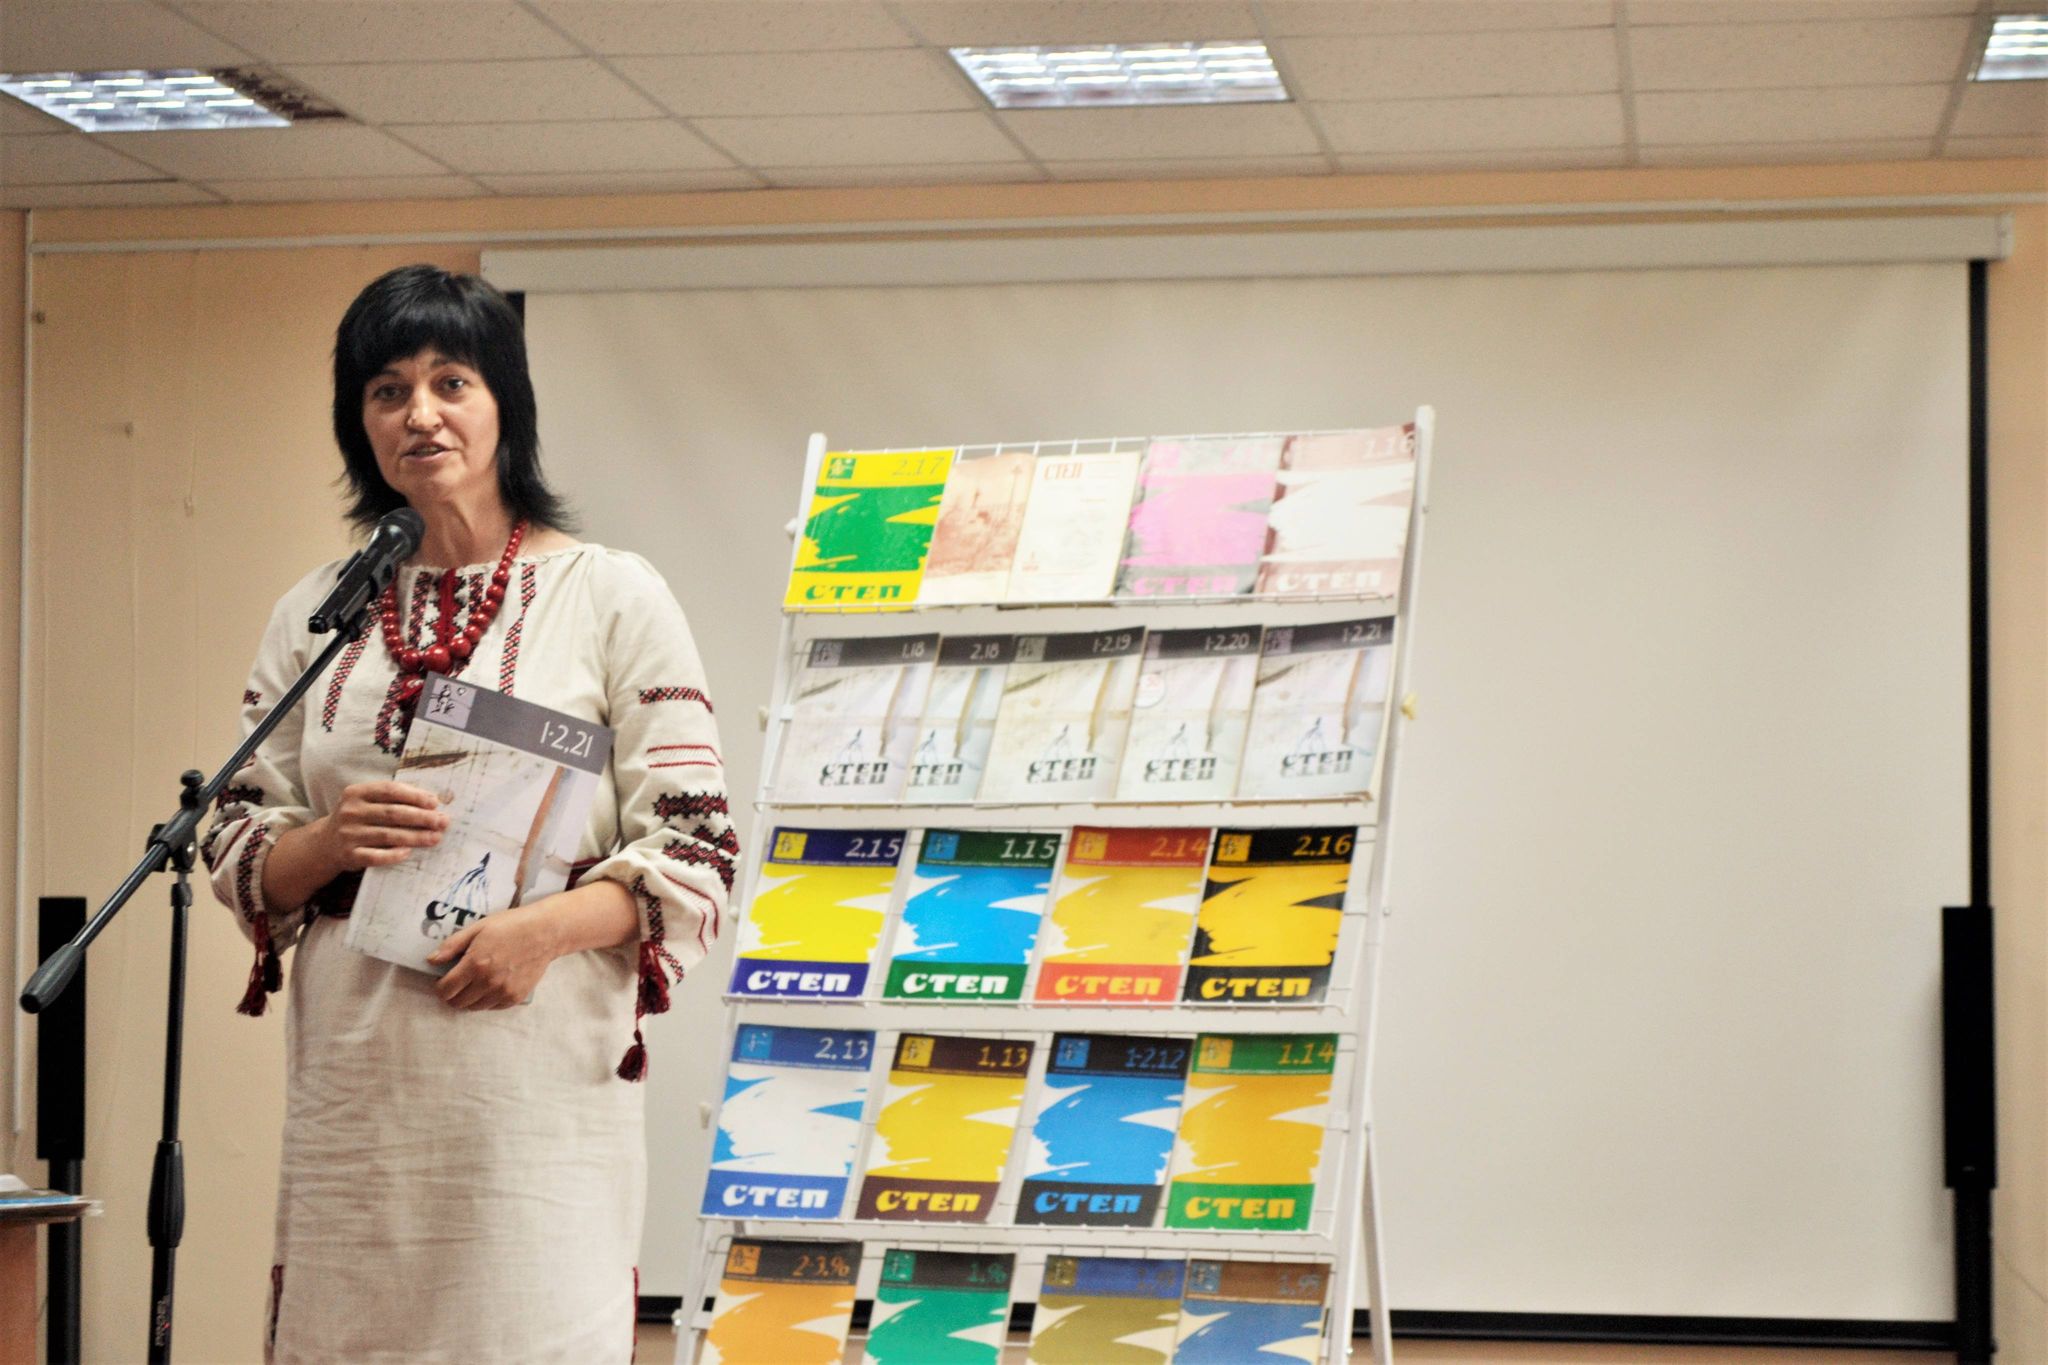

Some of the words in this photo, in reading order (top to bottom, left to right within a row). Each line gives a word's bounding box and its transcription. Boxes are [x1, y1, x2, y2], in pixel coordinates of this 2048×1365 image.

[892, 456, 946, 477] 2.17
[1043, 462, 1085, 480] СТЕП
[805, 584, 902, 600] СТЕП
[1132, 575, 1238, 595] СТЕП
[1275, 571, 1382, 592] СТЕП
[1028, 758, 1096, 777] СТЕП
[1145, 757, 1217, 773] СТЕП
[1281, 750, 1354, 768] СТЕП
[821, 761, 889, 779] СТЕП
[911, 763, 963, 779] ТЕП
[846, 838, 901, 859] 2.15
[1001, 839, 1057, 860] 1.15
[1151, 837, 1209, 858] 2.14
[1293, 834, 1352, 857] 2.16
[747, 970, 852, 992] СТЕП
[903, 973, 1009, 994] СТЕП
[1054, 975, 1162, 996] СТЕП
[1200, 977, 1312, 999] СТЕП
[1278, 1042, 1335, 1065] 1.14
[722, 1184, 829, 1209] СТЕП
[875, 1190, 981, 1213] СТЕП
[1034, 1191, 1142, 1214] СТЕП
[1185, 1196, 1296, 1219] СТЕП
